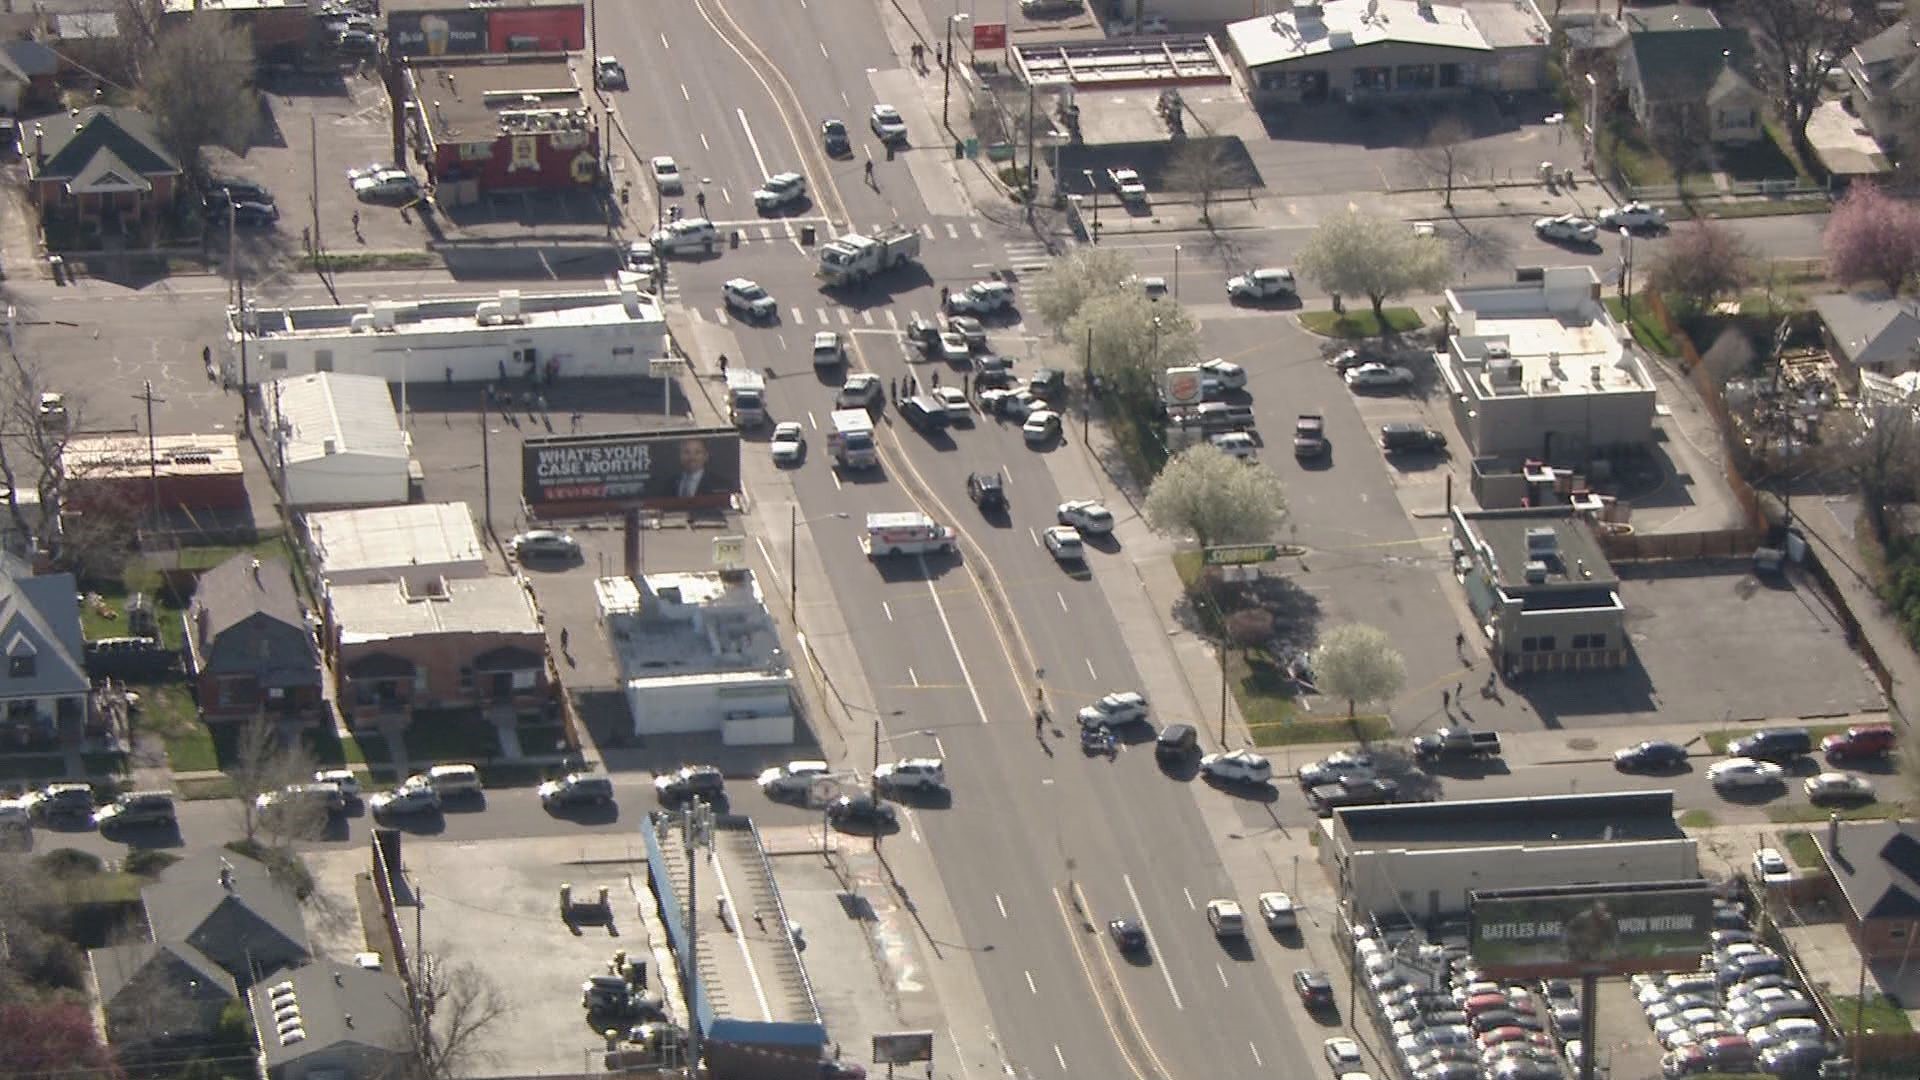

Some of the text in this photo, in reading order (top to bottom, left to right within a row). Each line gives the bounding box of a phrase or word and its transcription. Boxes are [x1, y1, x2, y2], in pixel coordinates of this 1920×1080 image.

[539, 445, 648, 464] WHAT'S YOUR
[537, 458, 651, 476] CASE WORTH?
